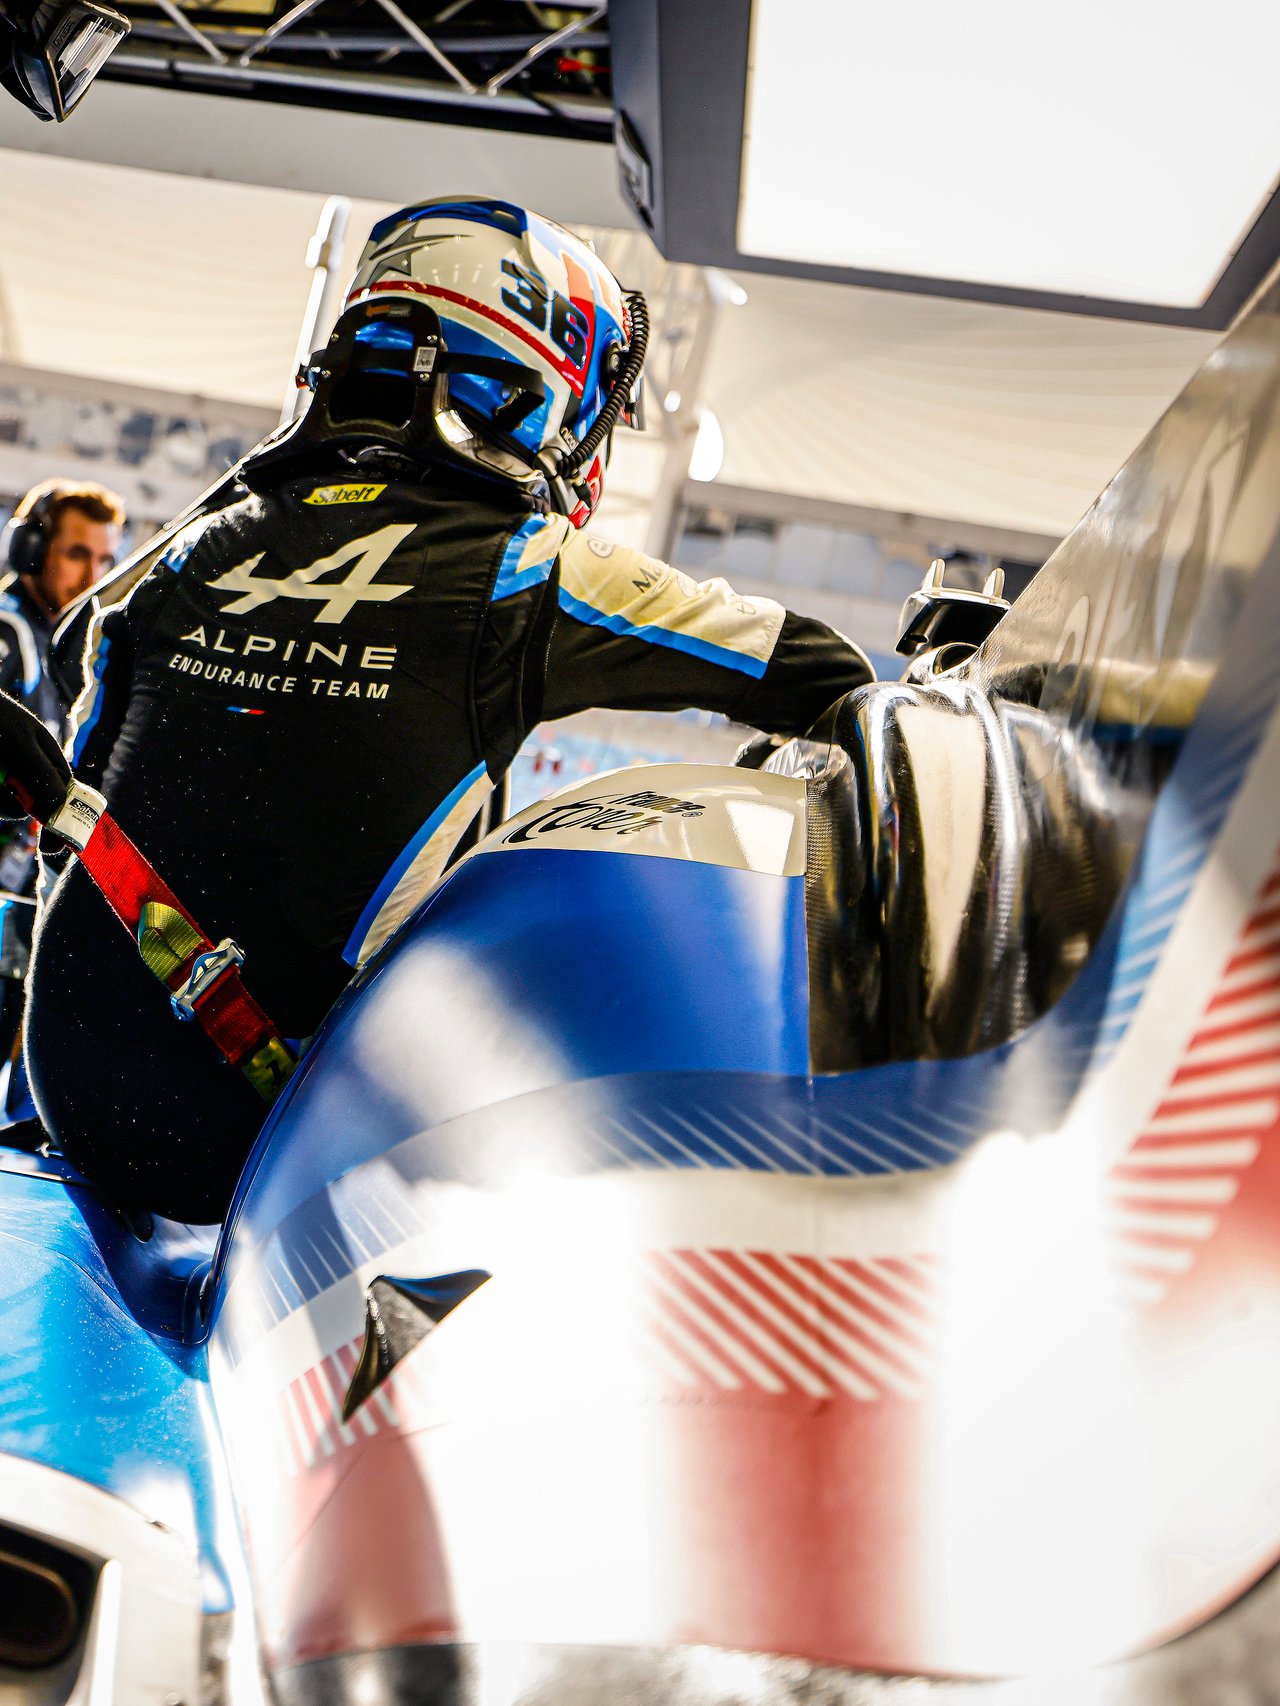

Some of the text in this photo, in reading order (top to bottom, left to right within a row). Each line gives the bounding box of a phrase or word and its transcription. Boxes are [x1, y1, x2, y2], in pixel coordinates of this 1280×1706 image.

[501, 258, 590, 371] 36
[314, 486, 375, 505] Sabelt
[180, 625, 398, 671] ALPINE
[169, 654, 390, 700] ENDURANCE TEAM
[73, 801, 100, 823] Sabelt
